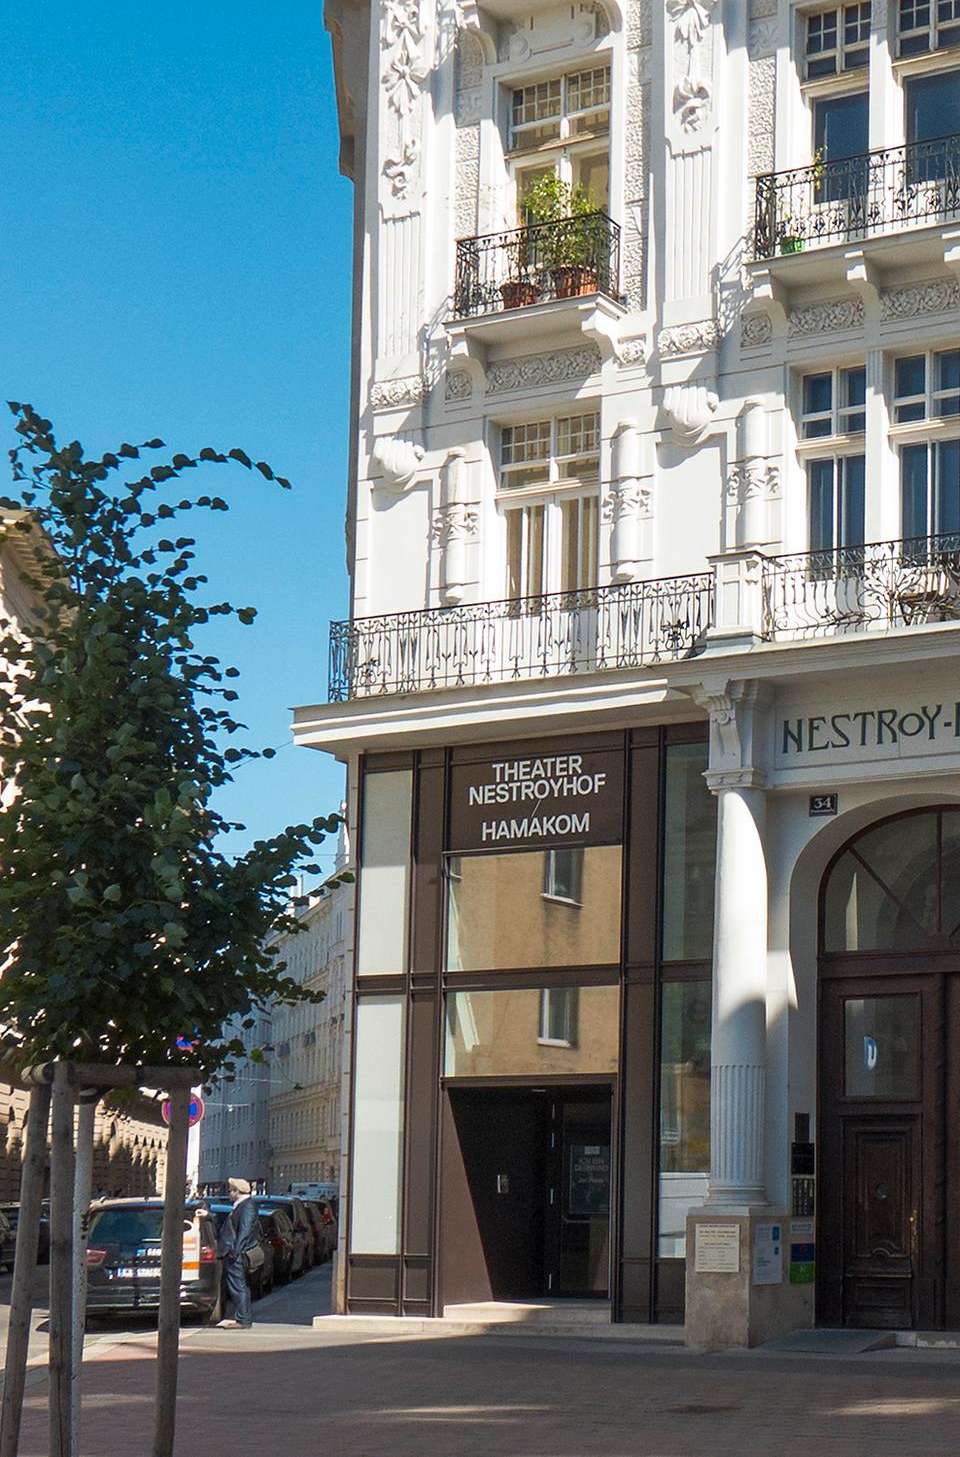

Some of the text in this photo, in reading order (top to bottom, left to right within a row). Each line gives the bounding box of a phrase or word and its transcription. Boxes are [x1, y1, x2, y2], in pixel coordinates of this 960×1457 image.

[492, 755, 582, 783] THEATER
[469, 773, 607, 806] NESTROYHOF
[814, 796, 832, 810] 34
[481, 812, 590, 841] HAMAKOM
